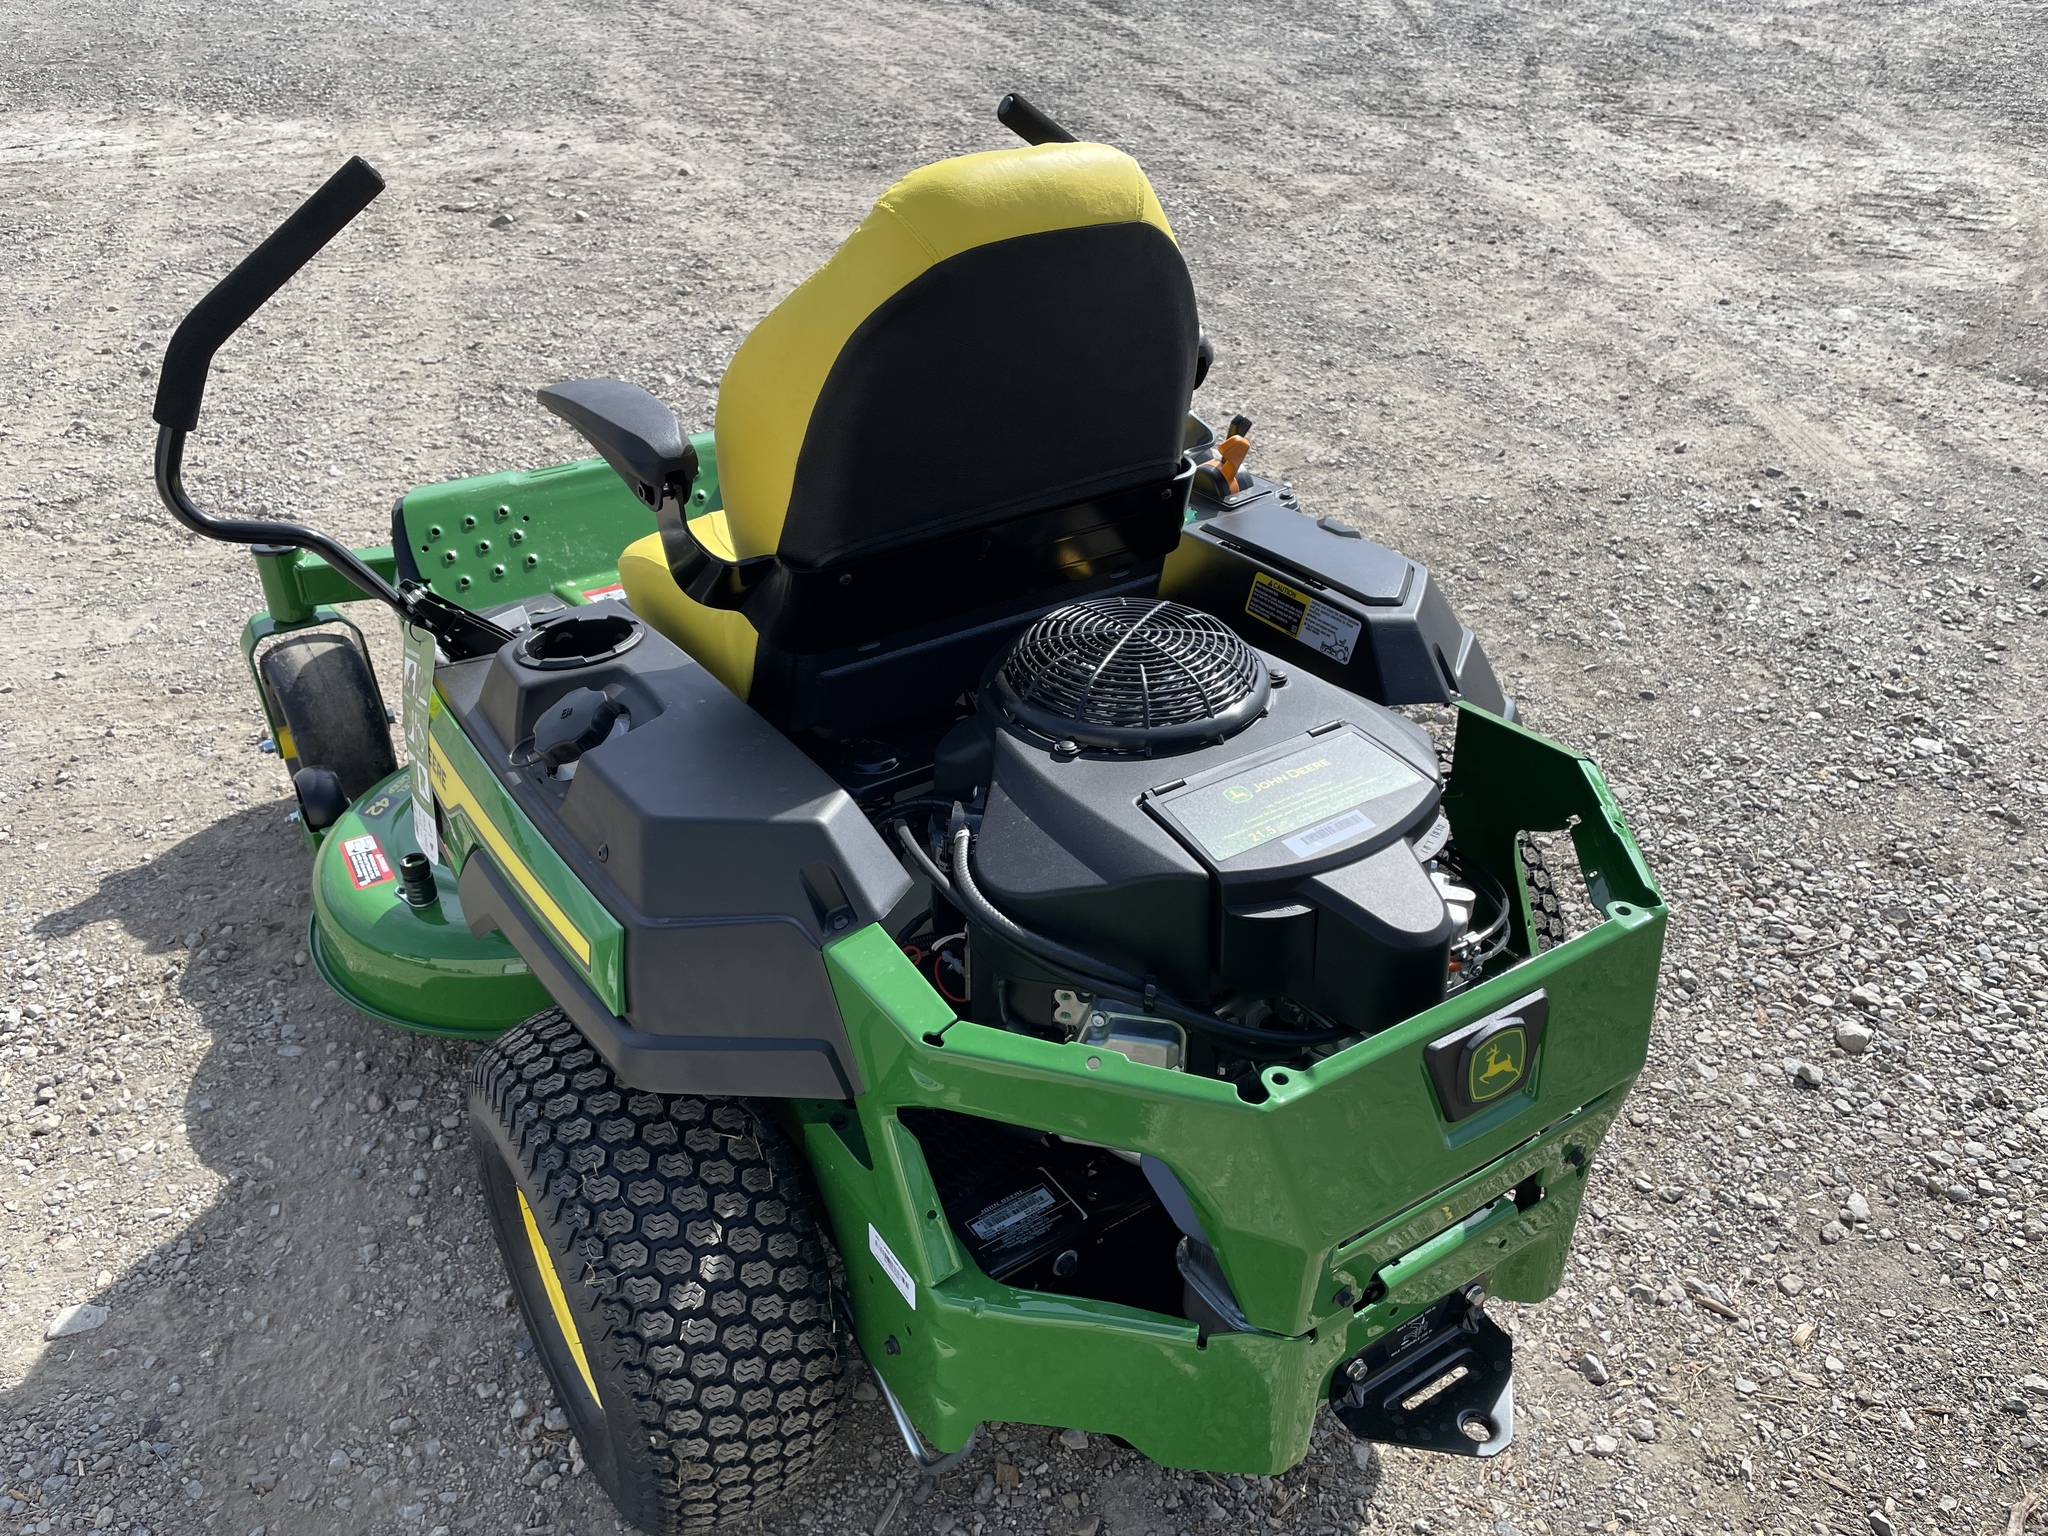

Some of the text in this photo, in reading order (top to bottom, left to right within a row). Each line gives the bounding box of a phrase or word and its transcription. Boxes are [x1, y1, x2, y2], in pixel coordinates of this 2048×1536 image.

[1273, 582, 1297, 598] CAUTION
[1253, 758, 1332, 793] JOHN DEERE
[365, 797, 390, 816] 42
[1248, 825, 1277, 842] 21.5
